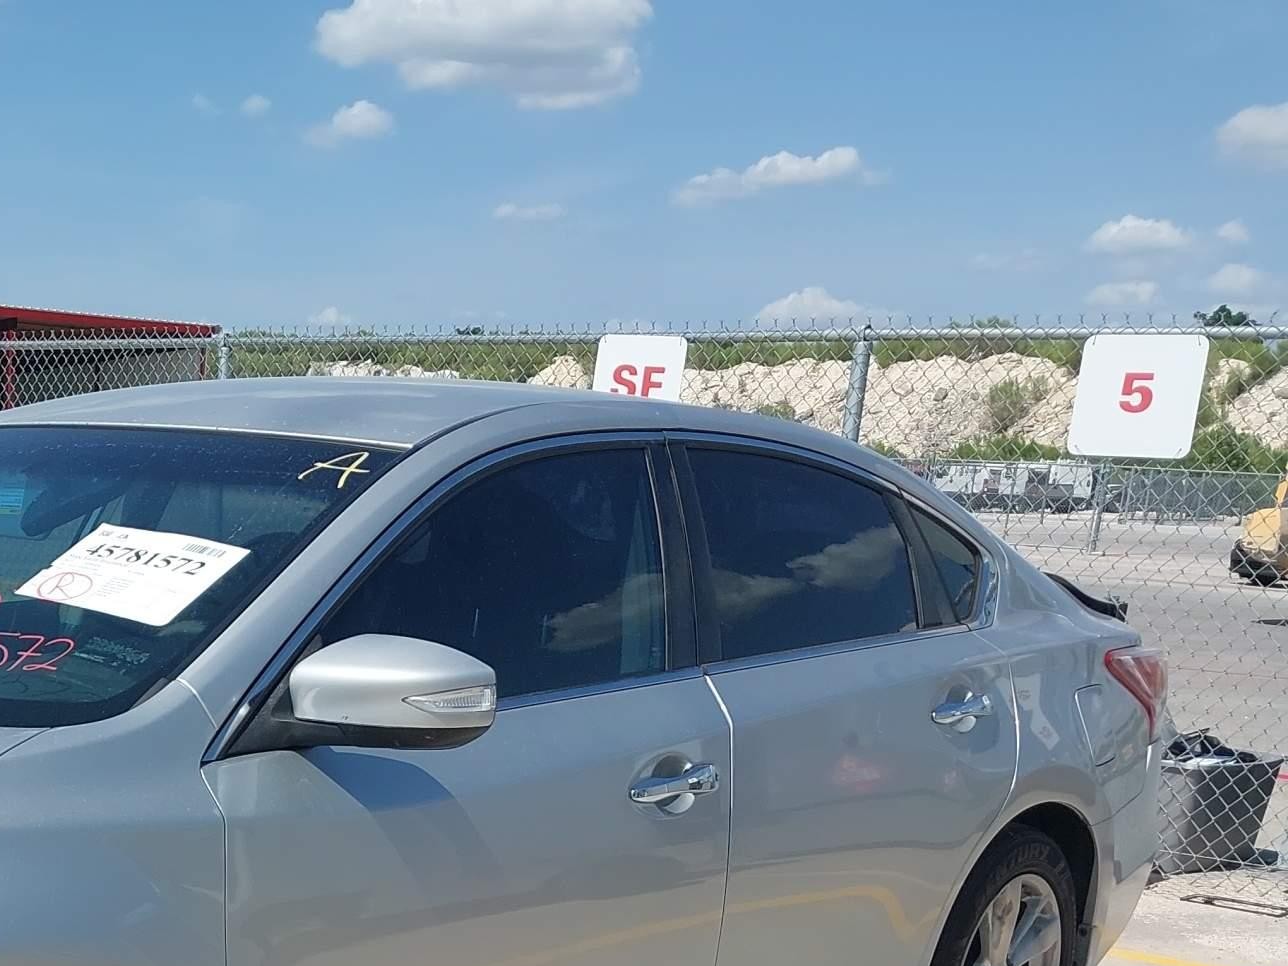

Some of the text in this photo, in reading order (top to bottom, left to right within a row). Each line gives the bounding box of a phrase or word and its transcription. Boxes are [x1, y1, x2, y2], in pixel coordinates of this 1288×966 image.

[610, 364, 665, 397] SF
[1119, 373, 1154, 413] 5
[298, 452, 370, 488] A
[86, 543, 206, 575] 45781572
